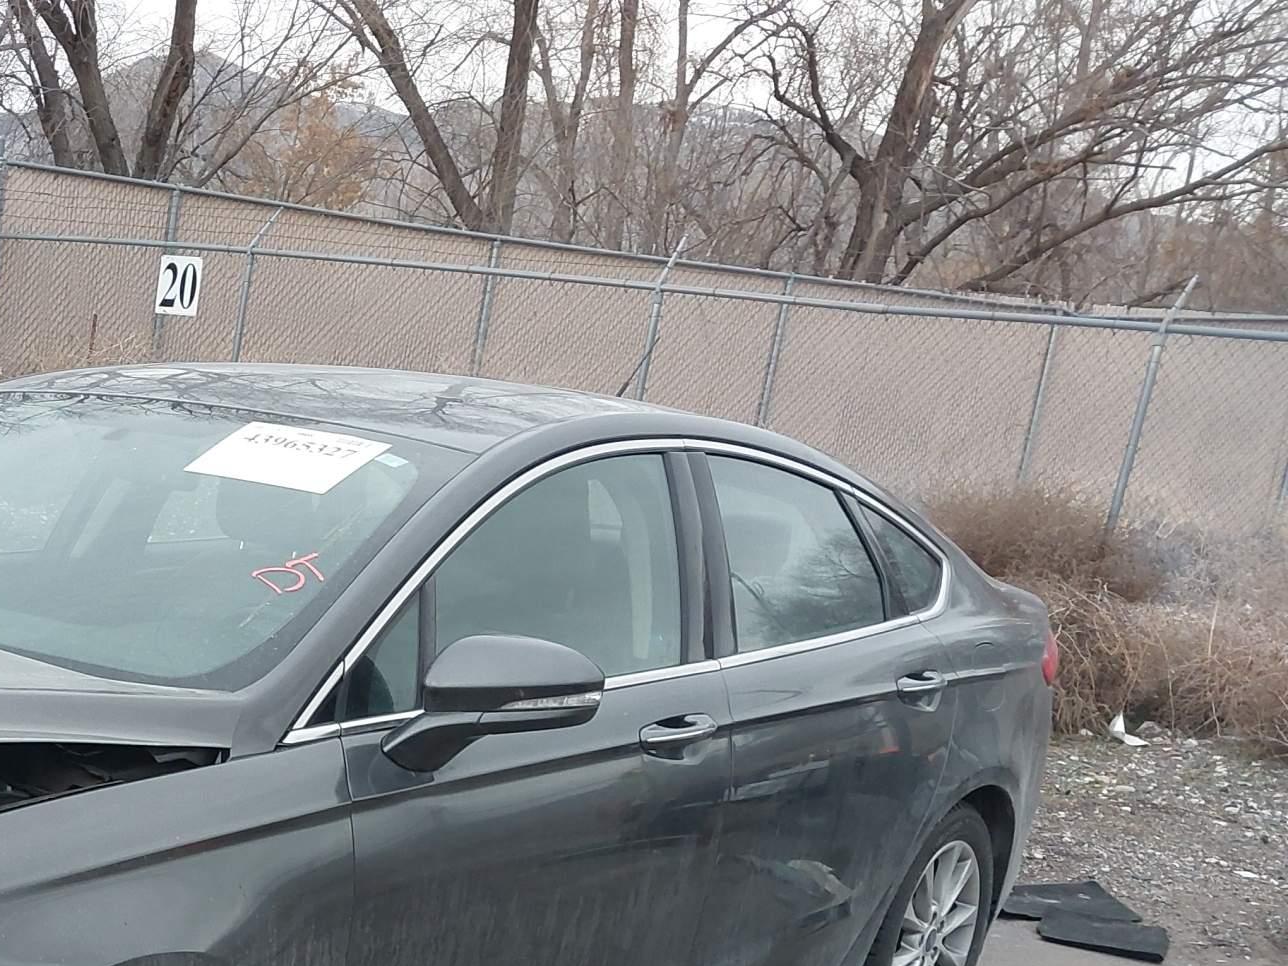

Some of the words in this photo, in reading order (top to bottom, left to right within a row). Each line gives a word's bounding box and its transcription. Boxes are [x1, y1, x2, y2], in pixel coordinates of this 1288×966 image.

[159, 262, 198, 310] 20
[243, 433, 358, 459] 43965327
[251, 551, 325, 596] DT
